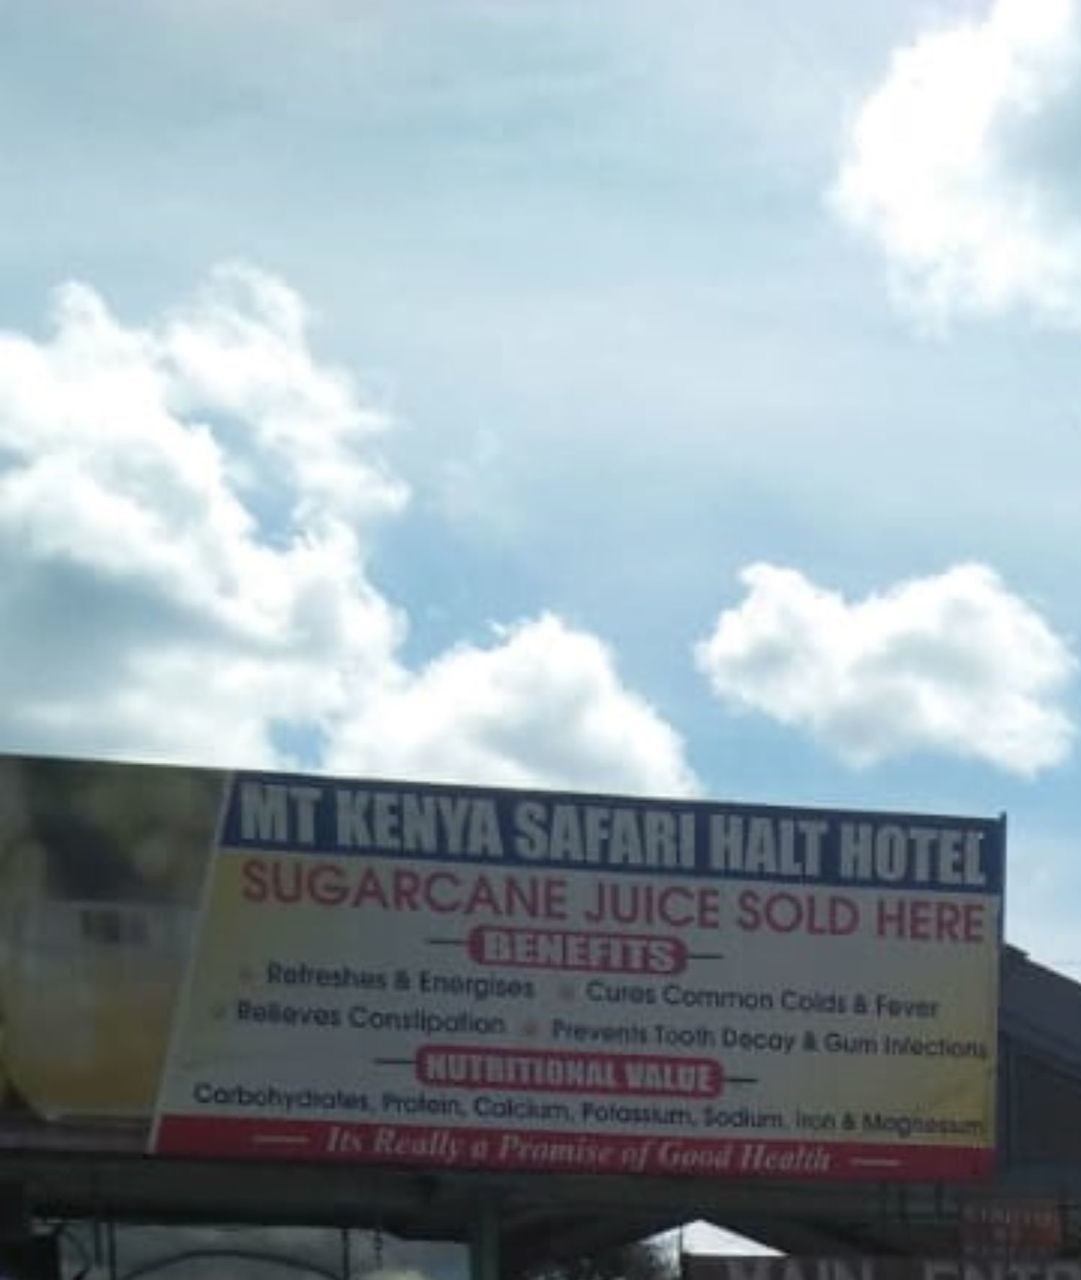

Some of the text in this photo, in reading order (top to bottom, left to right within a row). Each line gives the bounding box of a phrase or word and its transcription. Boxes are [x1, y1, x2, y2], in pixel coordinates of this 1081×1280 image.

[240, 782, 985, 885] MT KENYA SAFARI HALT HOTEL
[243, 859, 984, 943] SUGARCANE JUICE SOLD HERE
[483, 932, 676, 971] BENEFITS
[267, 962, 535, 1000] Refreshes & Energises
[586, 981, 938, 1019] Cures Common Colds & Fever
[237, 1001, 505, 1043] Relieves Constipation
[552, 1019, 647, 1044] Prevents
[655, 1024, 713, 1047] Tooth
[722, 1029, 794, 1056] Decay
[825, 1034, 877, 1054] Gum
[885, 1038, 986, 1060] Infections
[425, 1054, 713, 1093] NUTRITIONAL VALUE
[374, 1128, 459, 1163] Really
[471, 1141, 488, 1160] a
[499, 1136, 611, 1165] Promise
[622, 1143, 651, 1173] of
[659, 1142, 732, 1169] Good
[740, 1146, 830, 1172] Health
